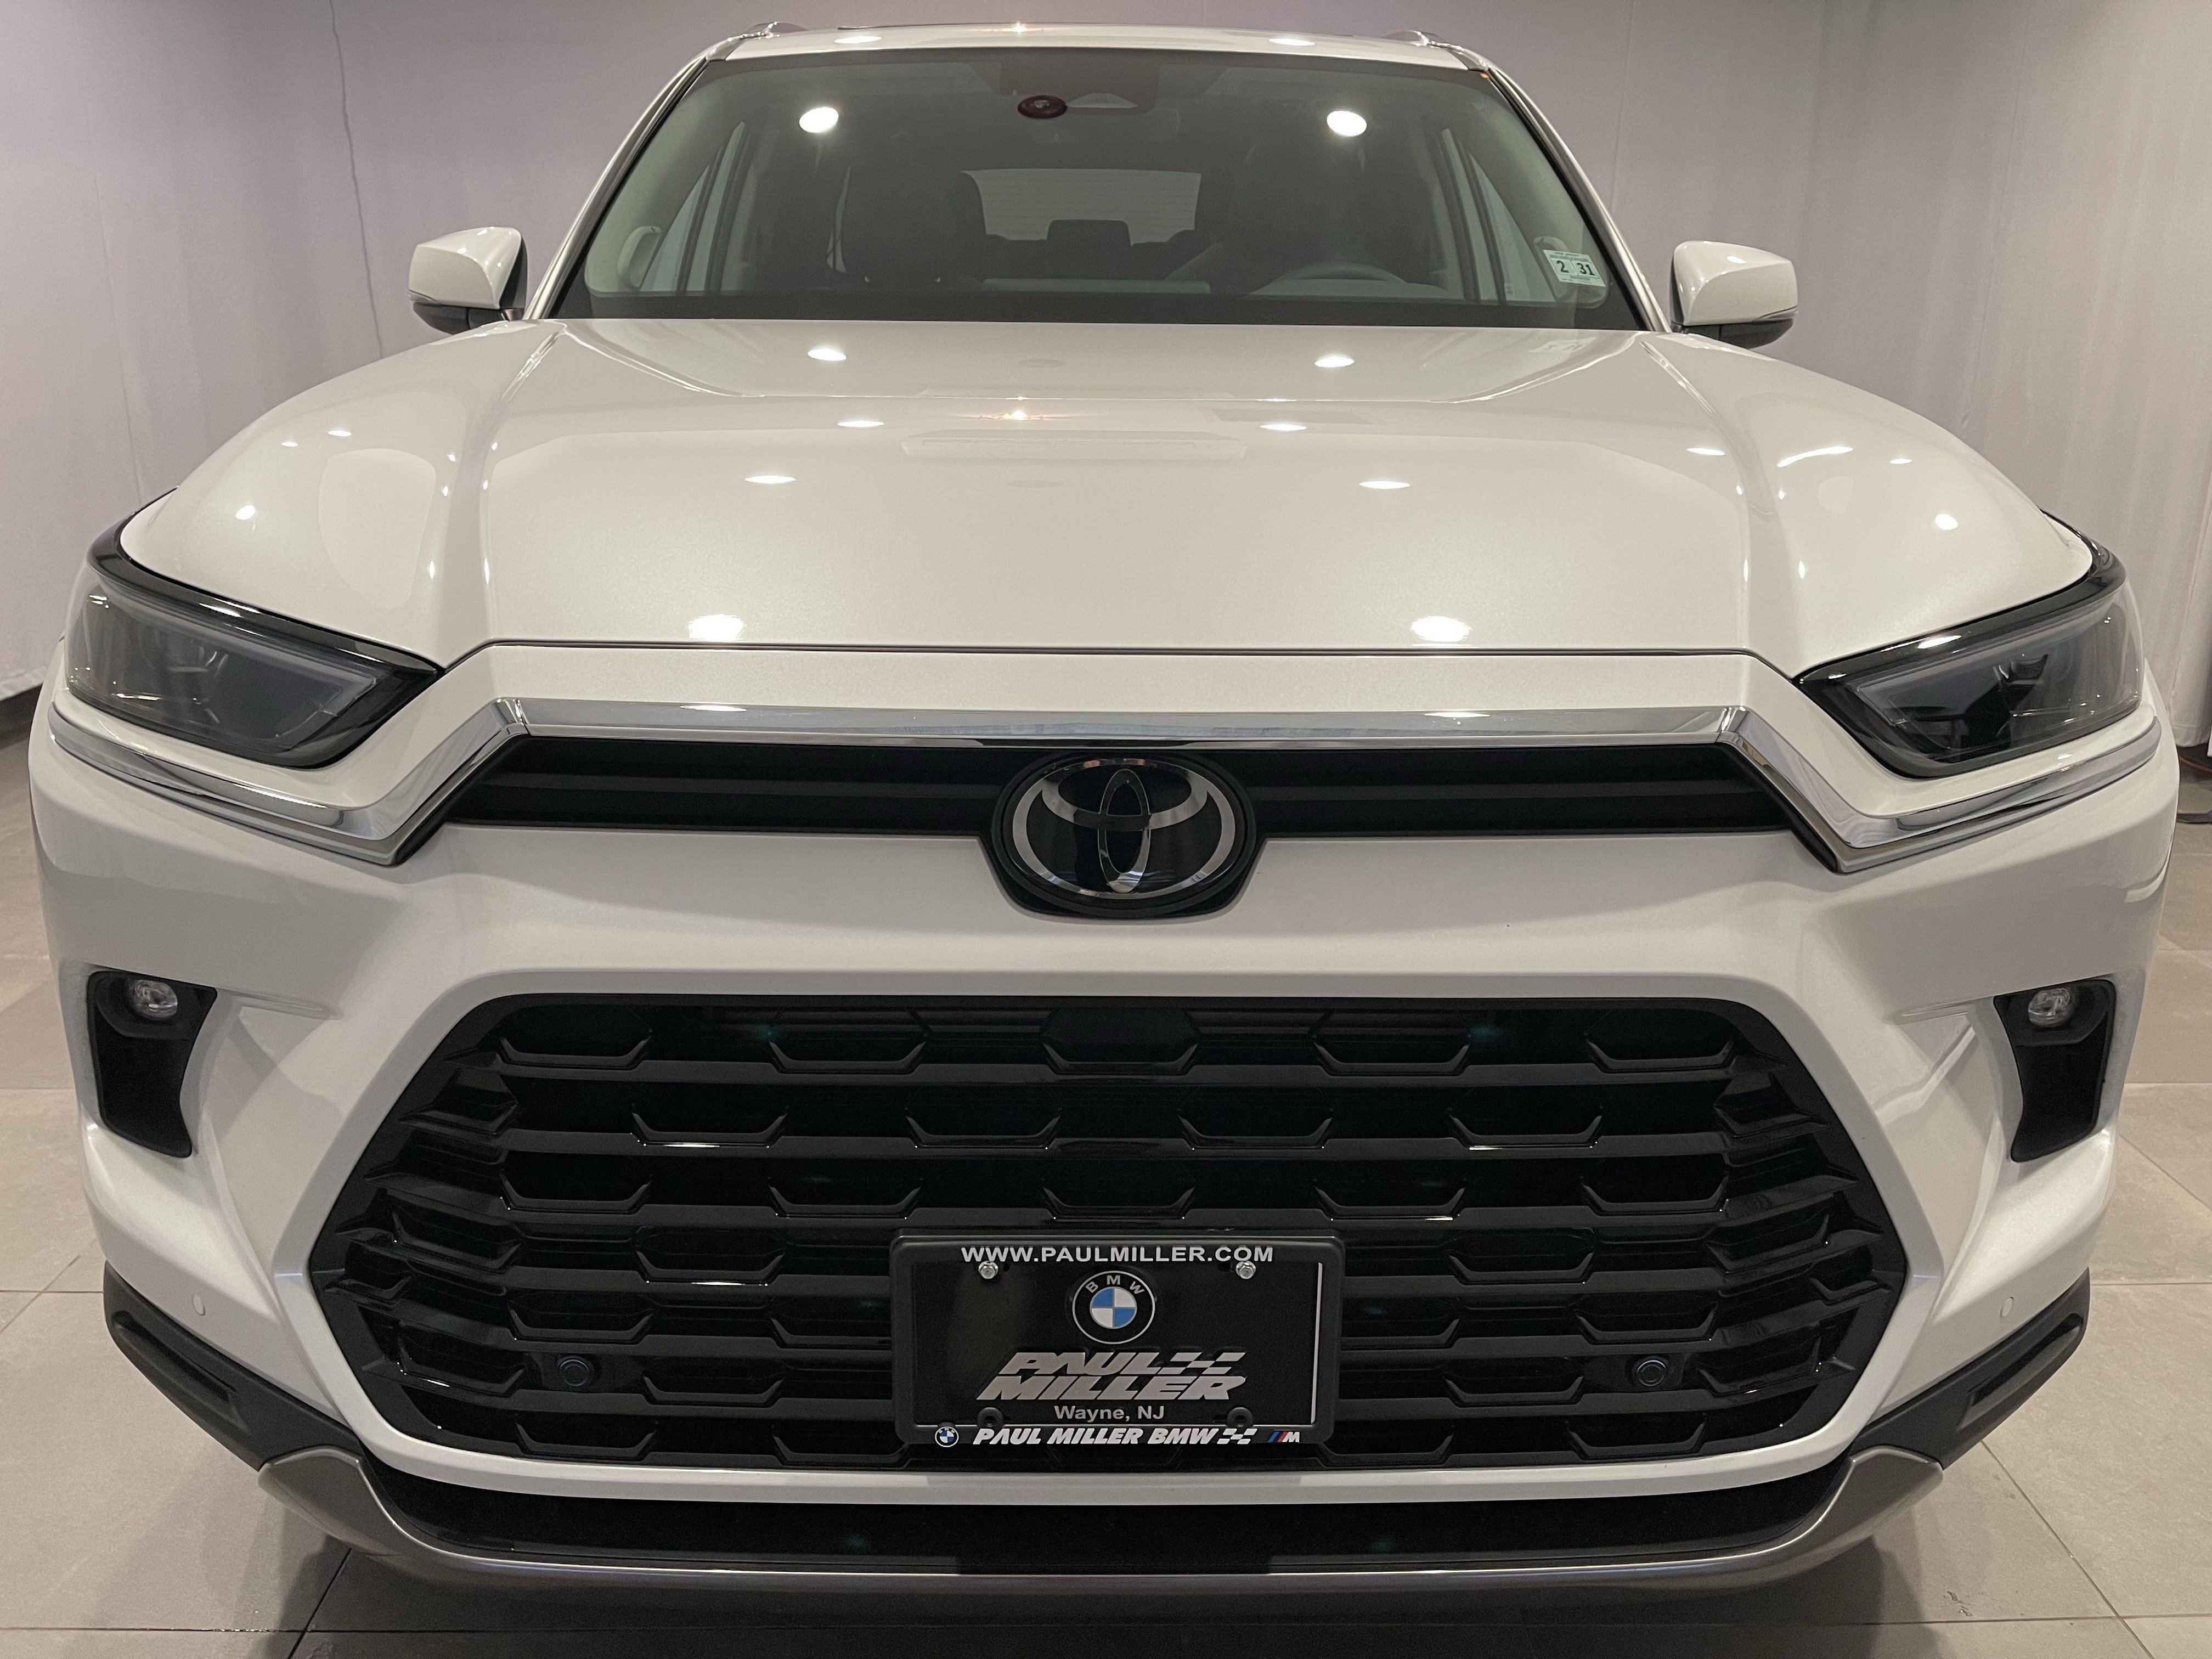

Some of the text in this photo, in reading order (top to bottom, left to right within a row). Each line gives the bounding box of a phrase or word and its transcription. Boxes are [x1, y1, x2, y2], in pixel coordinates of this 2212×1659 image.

[1556, 260, 1596, 276] 2 31
[961, 1246, 1273, 1262] WWW.PAULMILLER.COM
[1085, 1275, 1145, 1294] BMW
[998, 1352, 1161, 1375] PAUL
[976, 1376, 1246, 1400] MILLER
[1054, 1405, 1165, 1423] Wayne, NJ
[973, 1428, 1220, 1444] PAUL MILLER BMW
